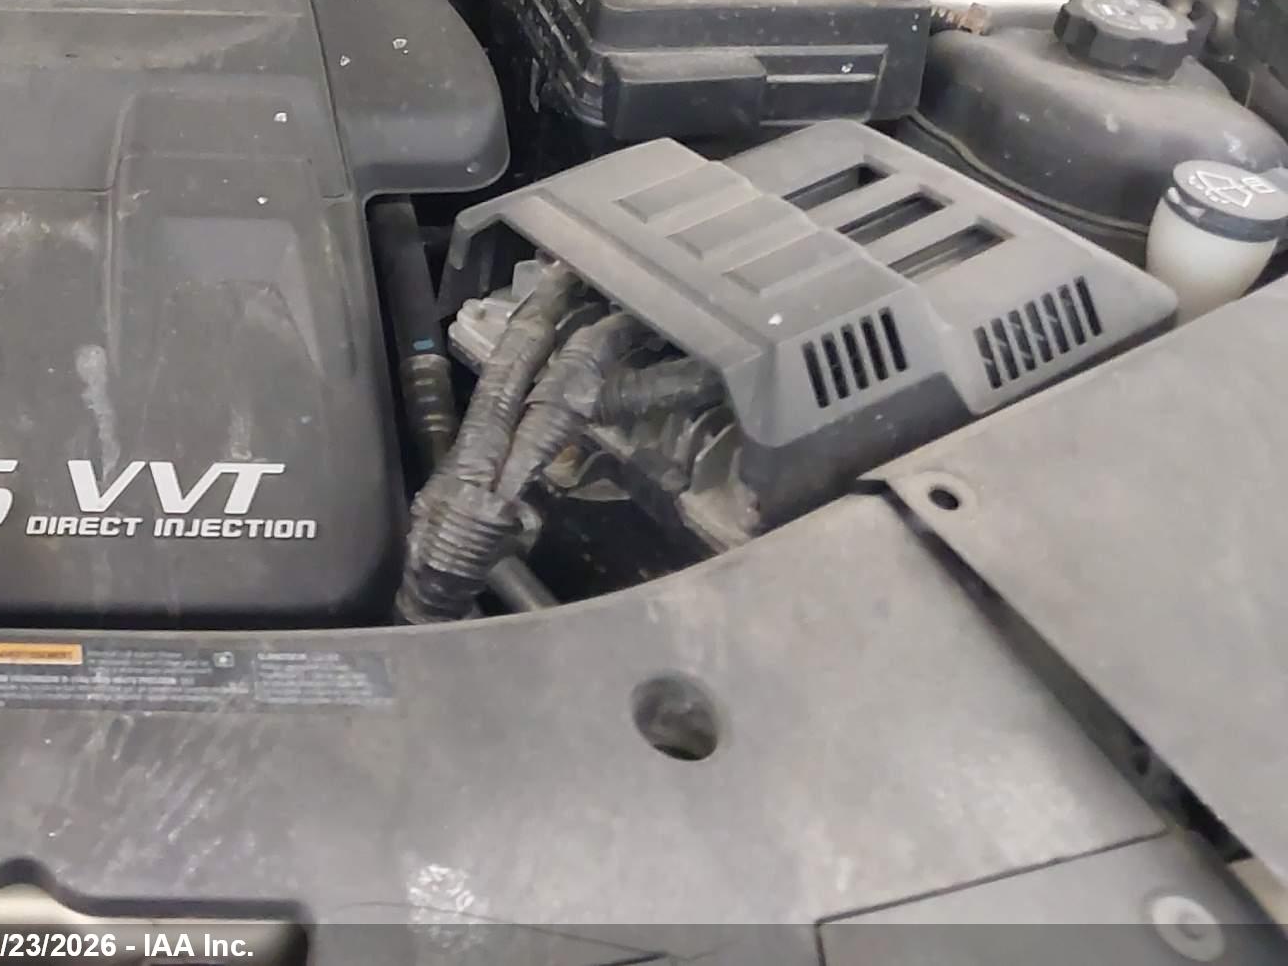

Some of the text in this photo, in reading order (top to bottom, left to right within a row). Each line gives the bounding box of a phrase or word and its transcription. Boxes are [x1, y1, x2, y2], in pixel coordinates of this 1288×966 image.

[68, 460, 285, 514] VVT
[26, 516, 316, 539] DIRECT INJECTION
